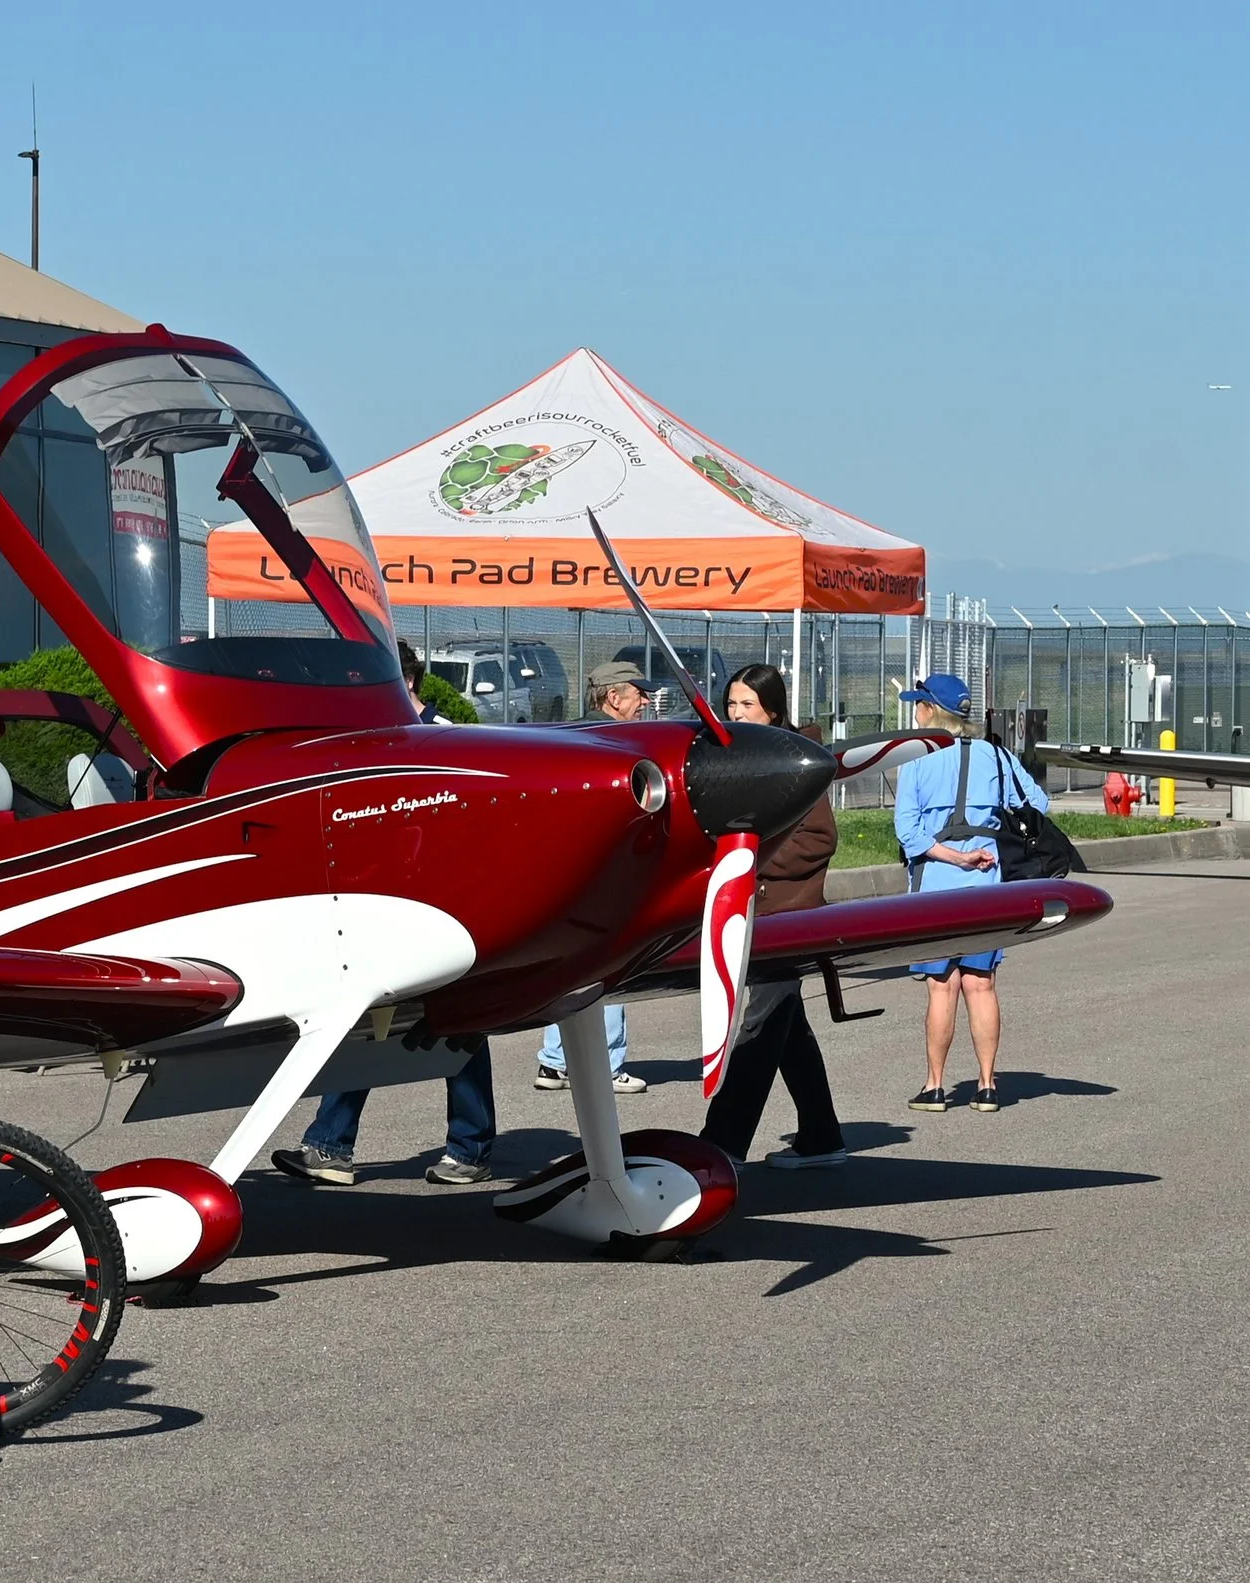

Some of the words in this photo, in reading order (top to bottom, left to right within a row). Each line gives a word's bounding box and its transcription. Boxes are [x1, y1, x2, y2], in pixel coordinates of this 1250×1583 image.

[440, 411, 646, 467] #craftbeerisourrocketfuel
[260, 554, 434, 585] Lnch
[450, 556, 534, 585] Pad
[551, 559, 752, 595] Brewery
[813, 561, 856, 592] Launch
[855, 566, 877, 592] Pad
[332, 803, 387, 822] Conatus
[390, 790, 458, 811] Superbia
